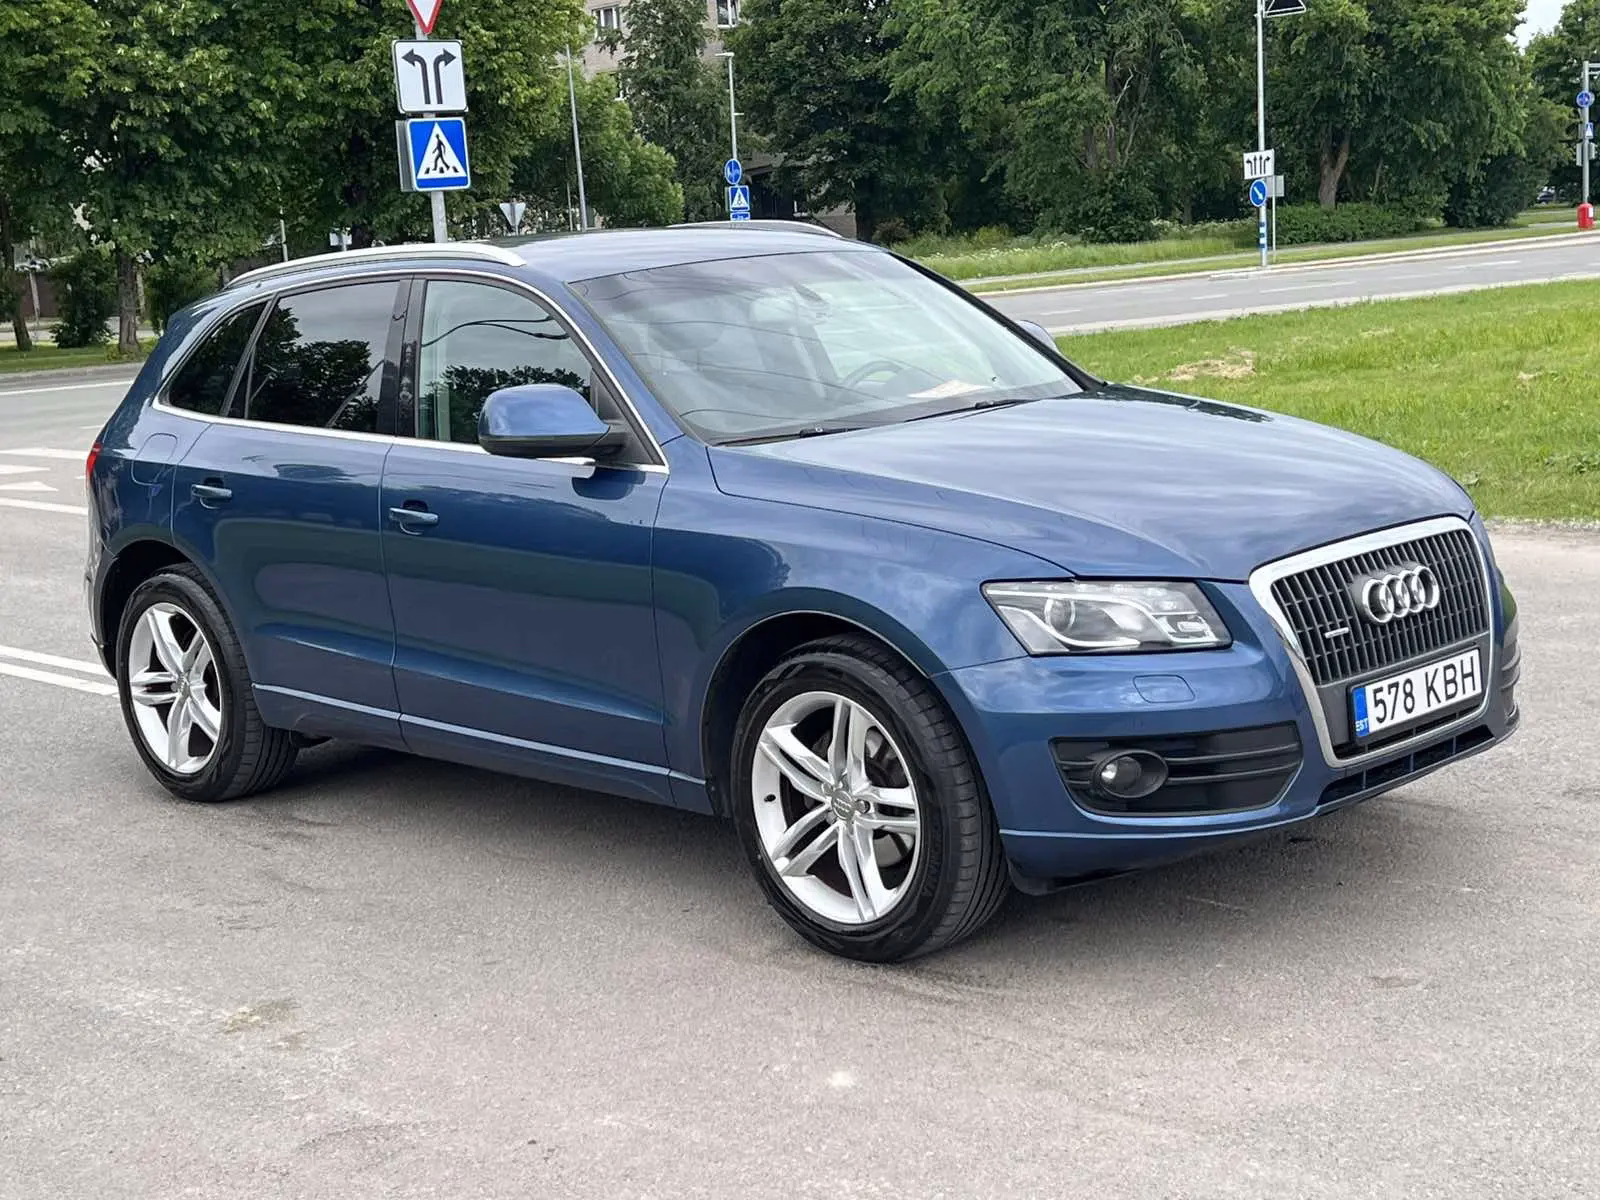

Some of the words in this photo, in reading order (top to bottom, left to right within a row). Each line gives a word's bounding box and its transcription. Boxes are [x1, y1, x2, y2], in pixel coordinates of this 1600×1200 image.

[1373, 678, 1415, 724] 578
[1425, 655, 1476, 707] KBH
[1356, 718, 1369, 731] EST
